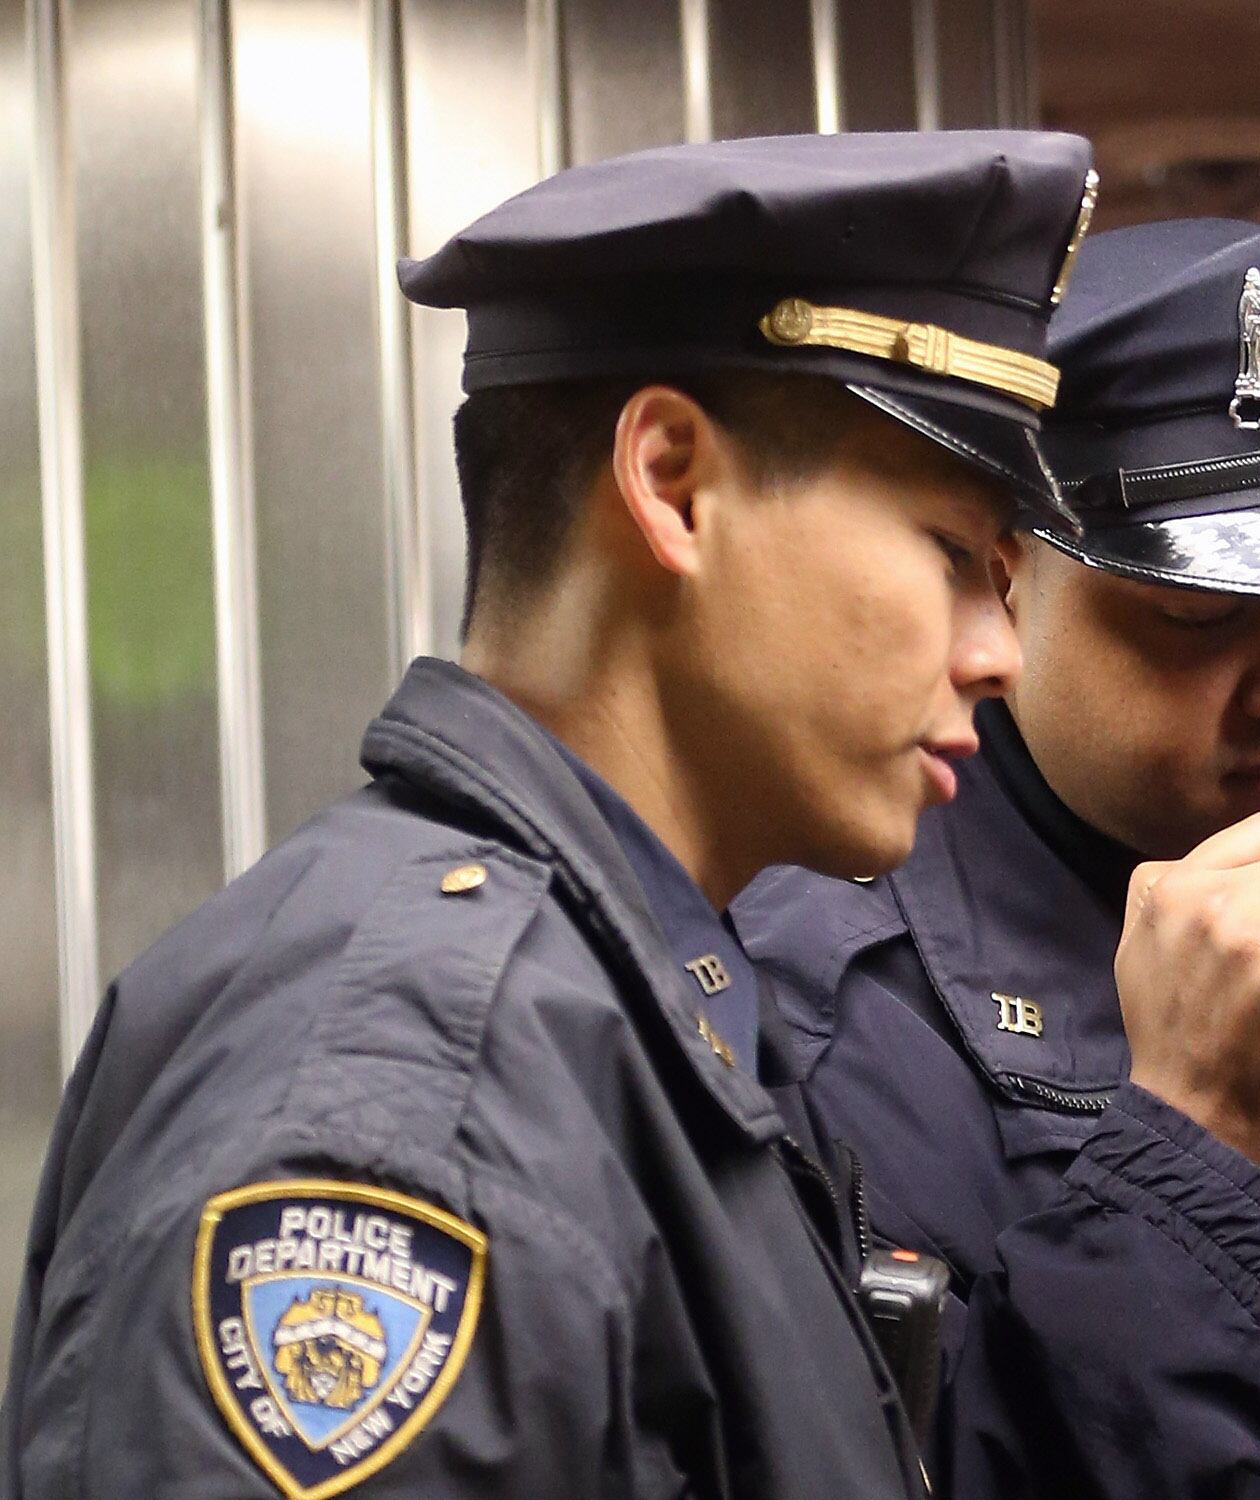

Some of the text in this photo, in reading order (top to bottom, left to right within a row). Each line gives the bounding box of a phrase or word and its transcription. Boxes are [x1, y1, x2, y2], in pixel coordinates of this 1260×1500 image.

[226, 1239, 457, 1312] DEPARTMENT
[281, 1207, 413, 1257] POLICE
[219, 1317, 292, 1438] CITY OF
[328, 1329, 451, 1465] NEW YORK
